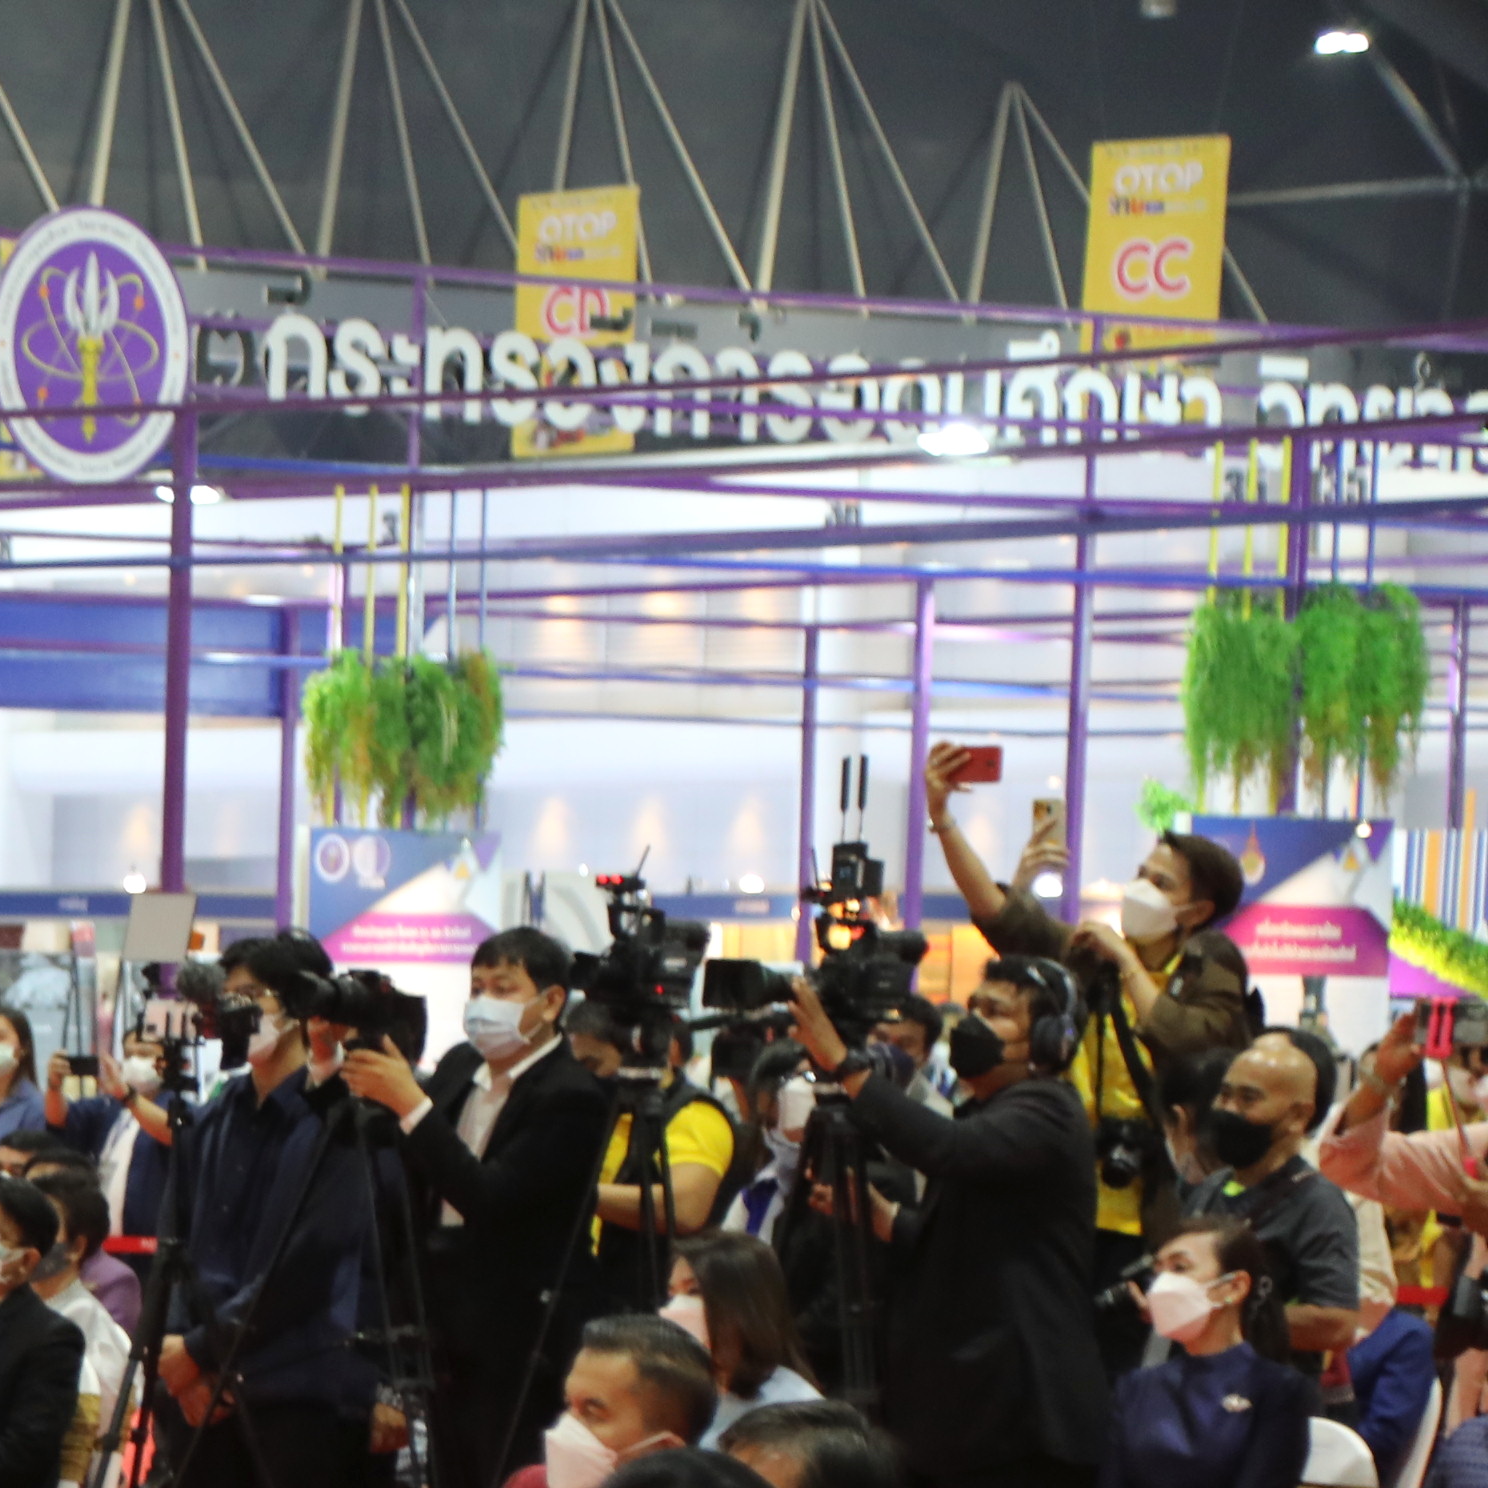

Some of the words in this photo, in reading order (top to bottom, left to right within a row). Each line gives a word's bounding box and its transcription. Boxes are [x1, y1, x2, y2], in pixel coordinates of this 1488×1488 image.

[1114, 161, 1204, 198] OTOP
[538, 211, 618, 245] OTOP
[1114, 238, 1193, 299] CC
[543, 283, 609, 337] CD
[264, 312, 1224, 458] กระทรวงการอดมศึกษา
